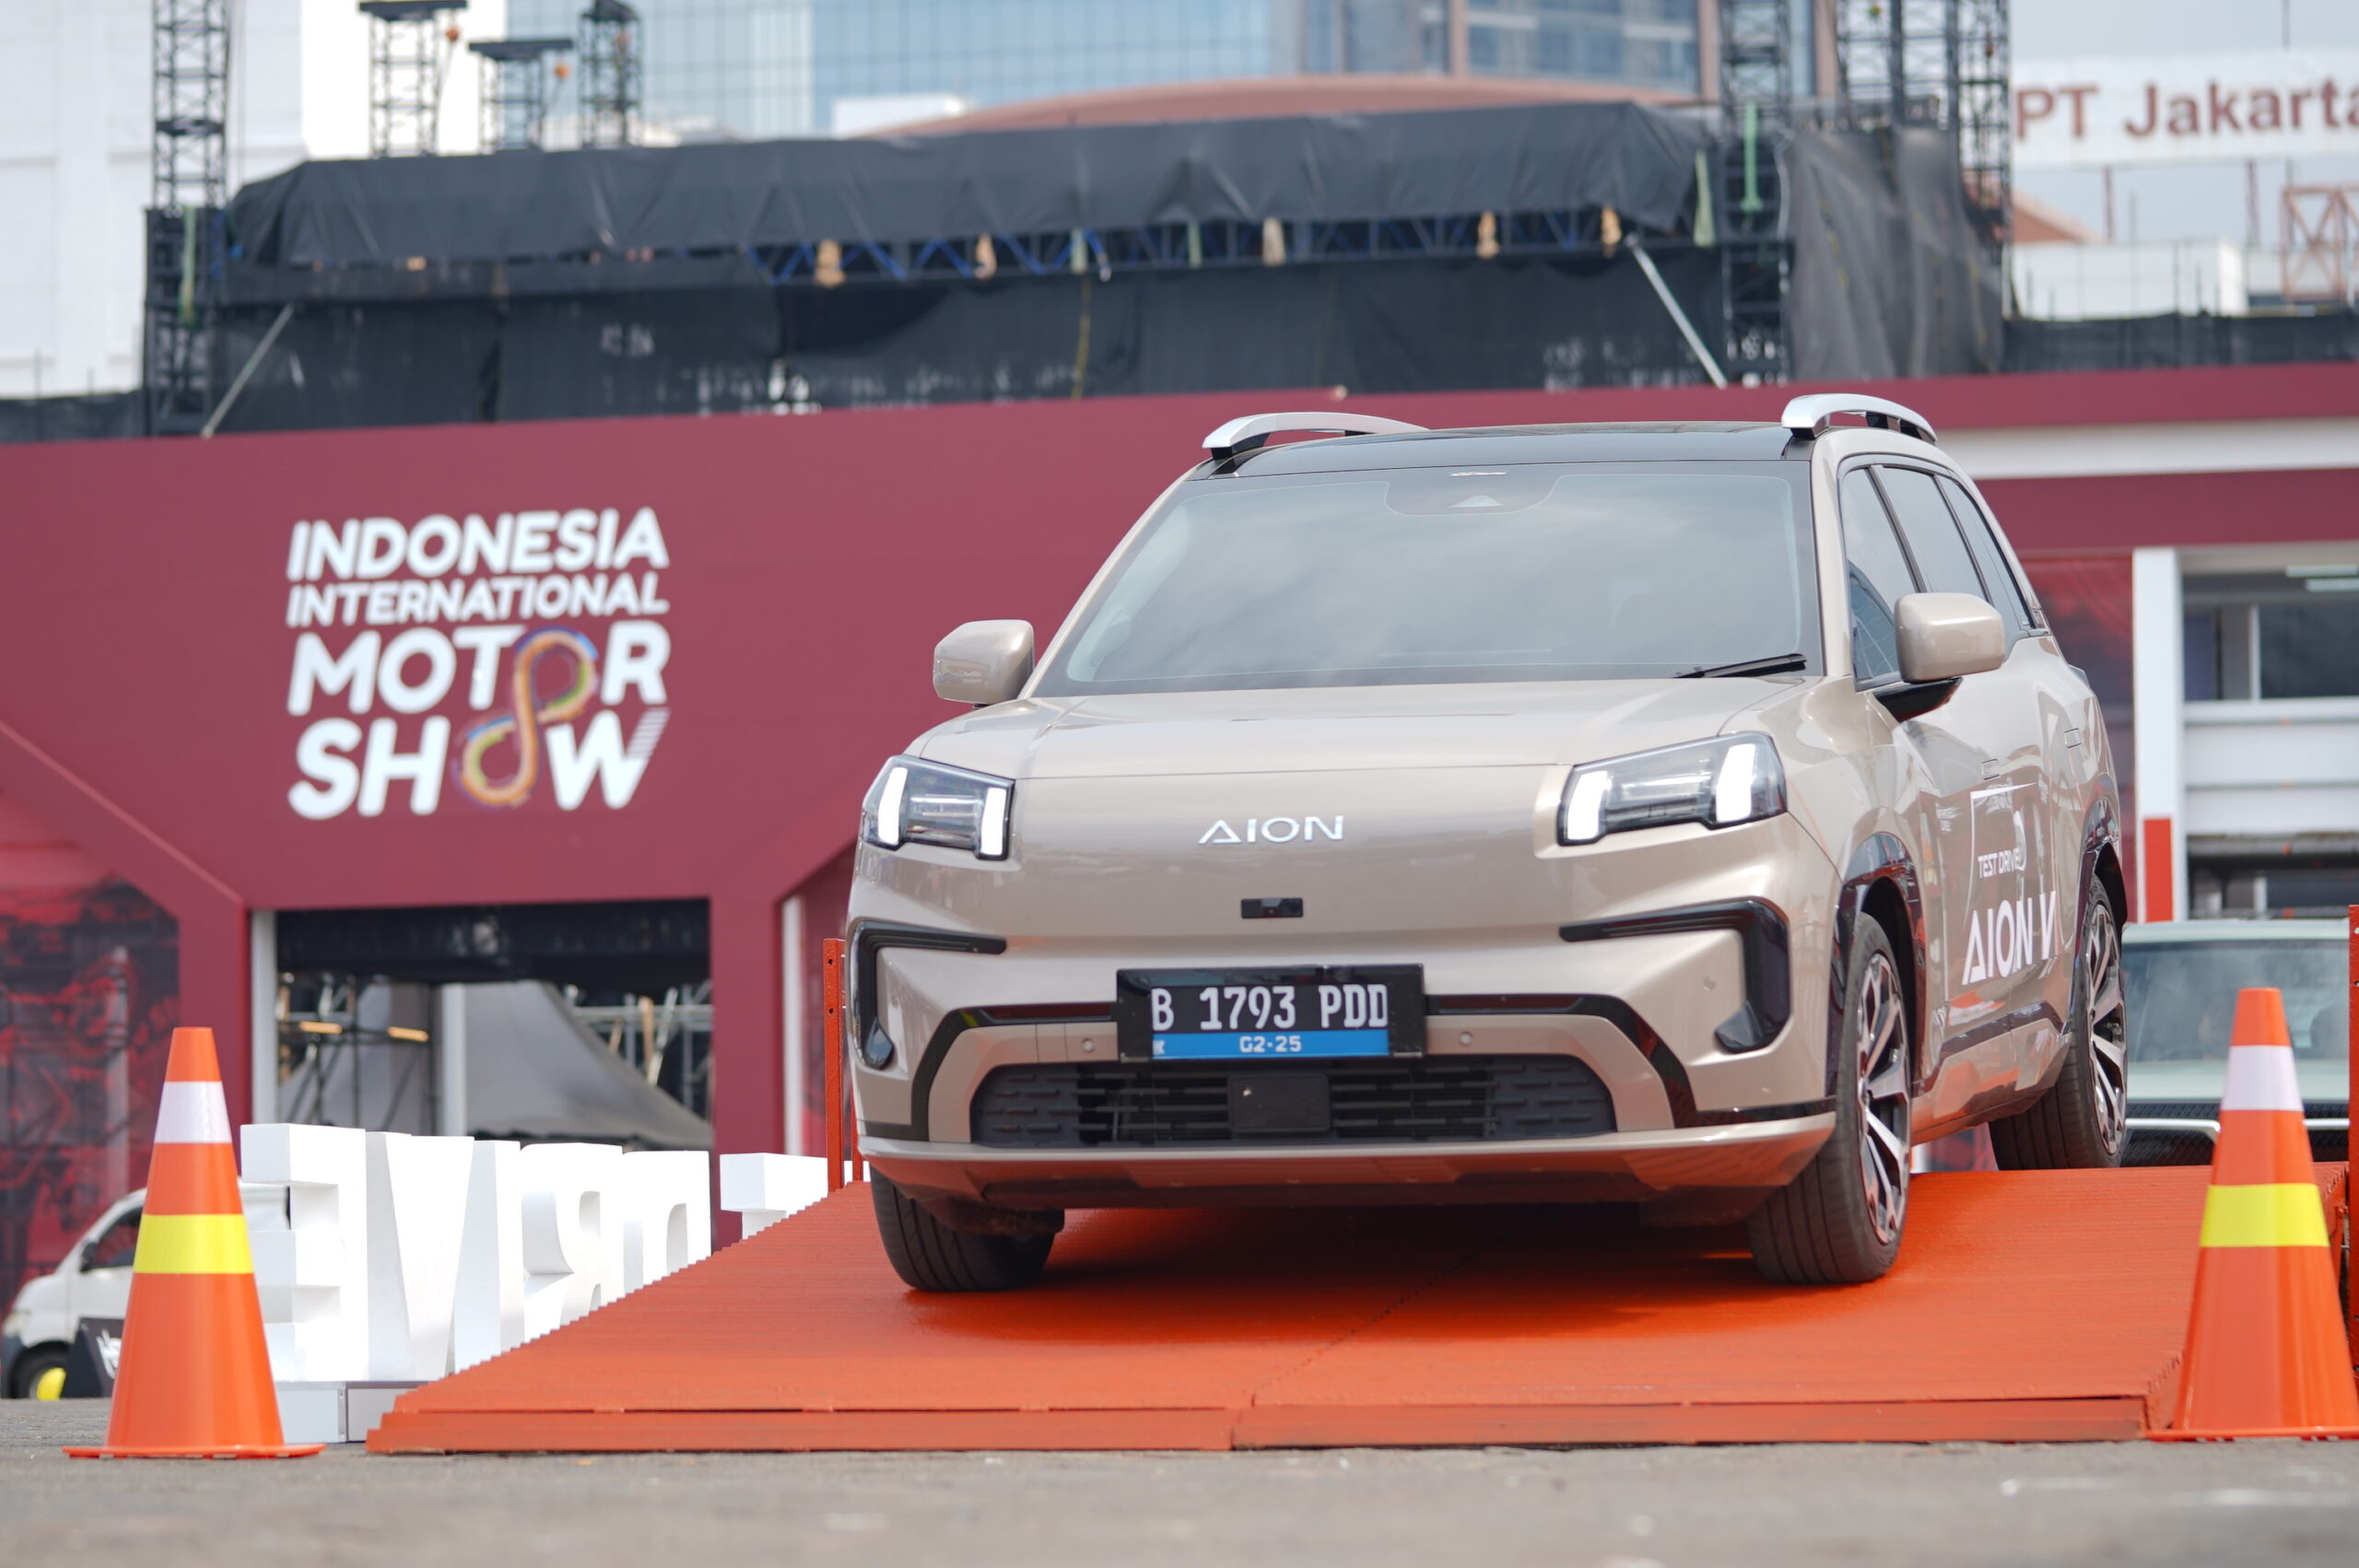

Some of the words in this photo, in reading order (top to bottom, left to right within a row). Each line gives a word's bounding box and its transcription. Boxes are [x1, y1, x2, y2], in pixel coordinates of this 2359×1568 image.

[2015, 85, 2098, 141] PT
[287, 506, 671, 582] INDONESIA
[286, 571, 671, 628] INTERNATIONAL
[287, 619, 671, 719] MOTOR
[288, 707, 671, 820] SHOW
[1198, 814, 1344, 845] AION
[1978, 853, 1998, 878] TEST
[1962, 897, 2033, 985] AION
[2039, 891, 2057, 960] V
[1151, 988, 1174, 1032] B
[1199, 985, 1297, 1031] 1793
[1318, 983, 1389, 1029] PDD
